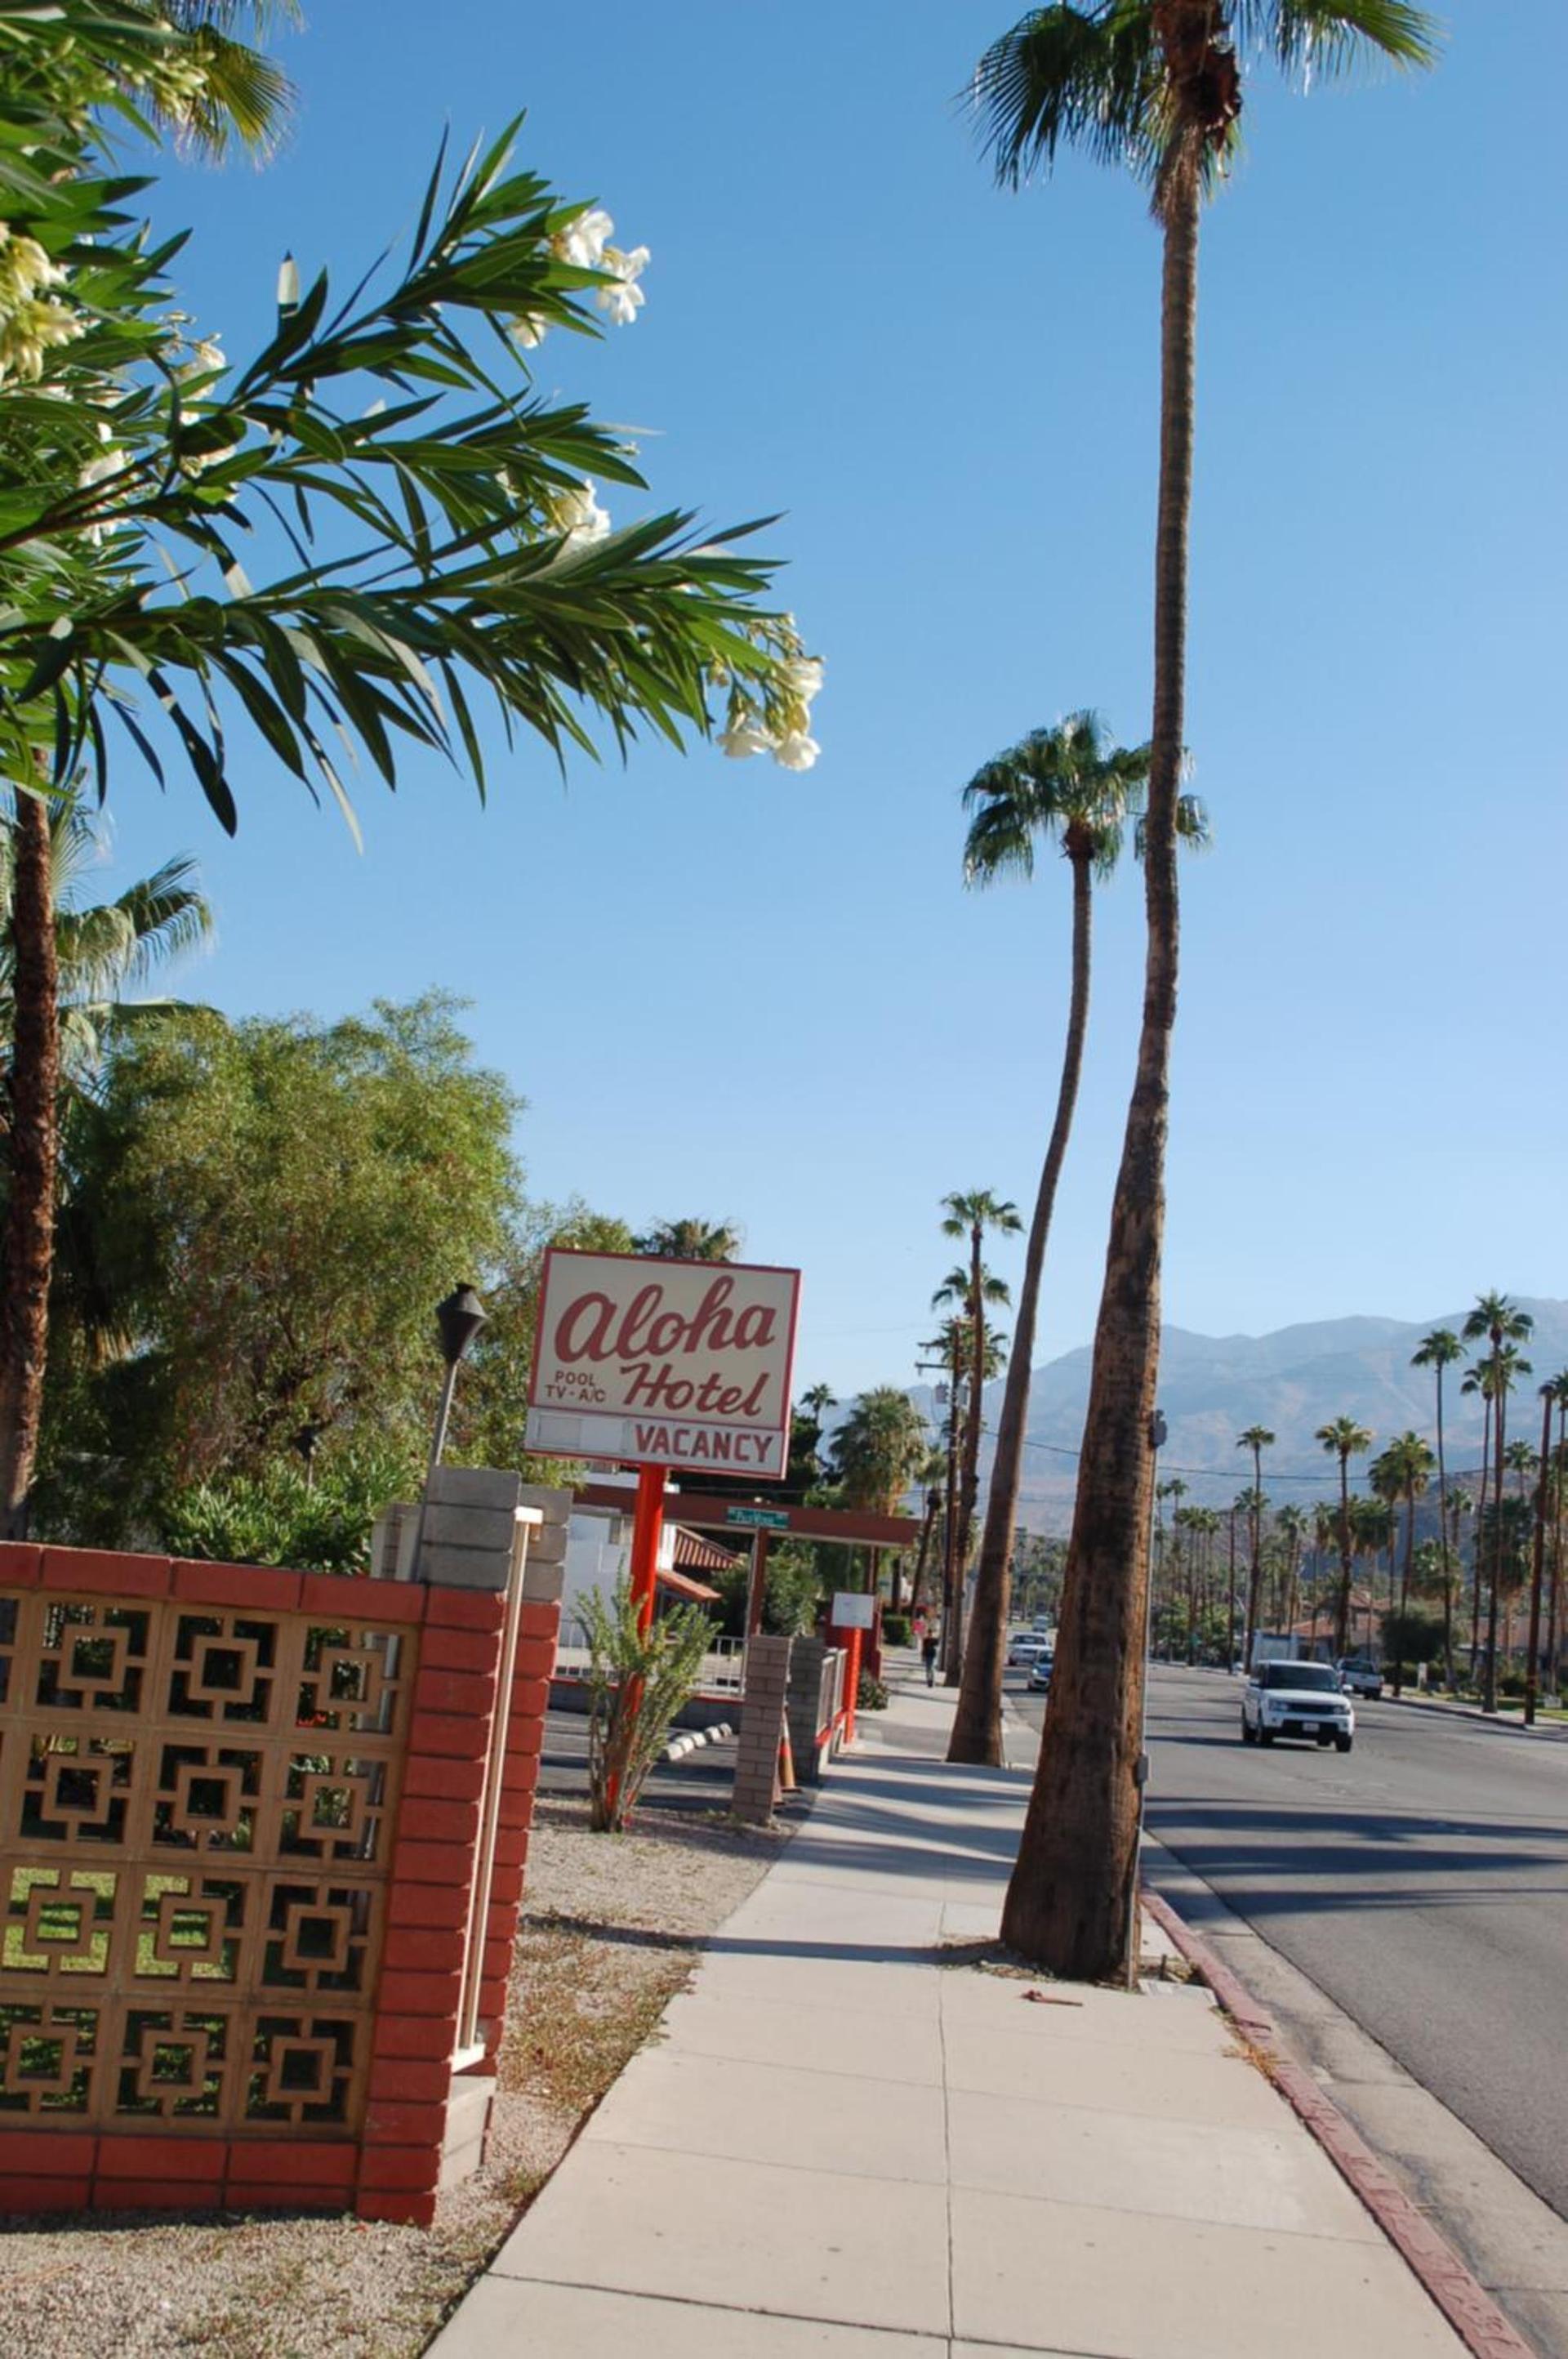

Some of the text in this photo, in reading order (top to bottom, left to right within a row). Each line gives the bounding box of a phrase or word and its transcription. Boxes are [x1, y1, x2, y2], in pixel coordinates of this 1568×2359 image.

[555, 1370, 595, 1387] POOL
[620, 1362, 770, 1416] Hotel
[635, 1424, 773, 1463] VACANCY
